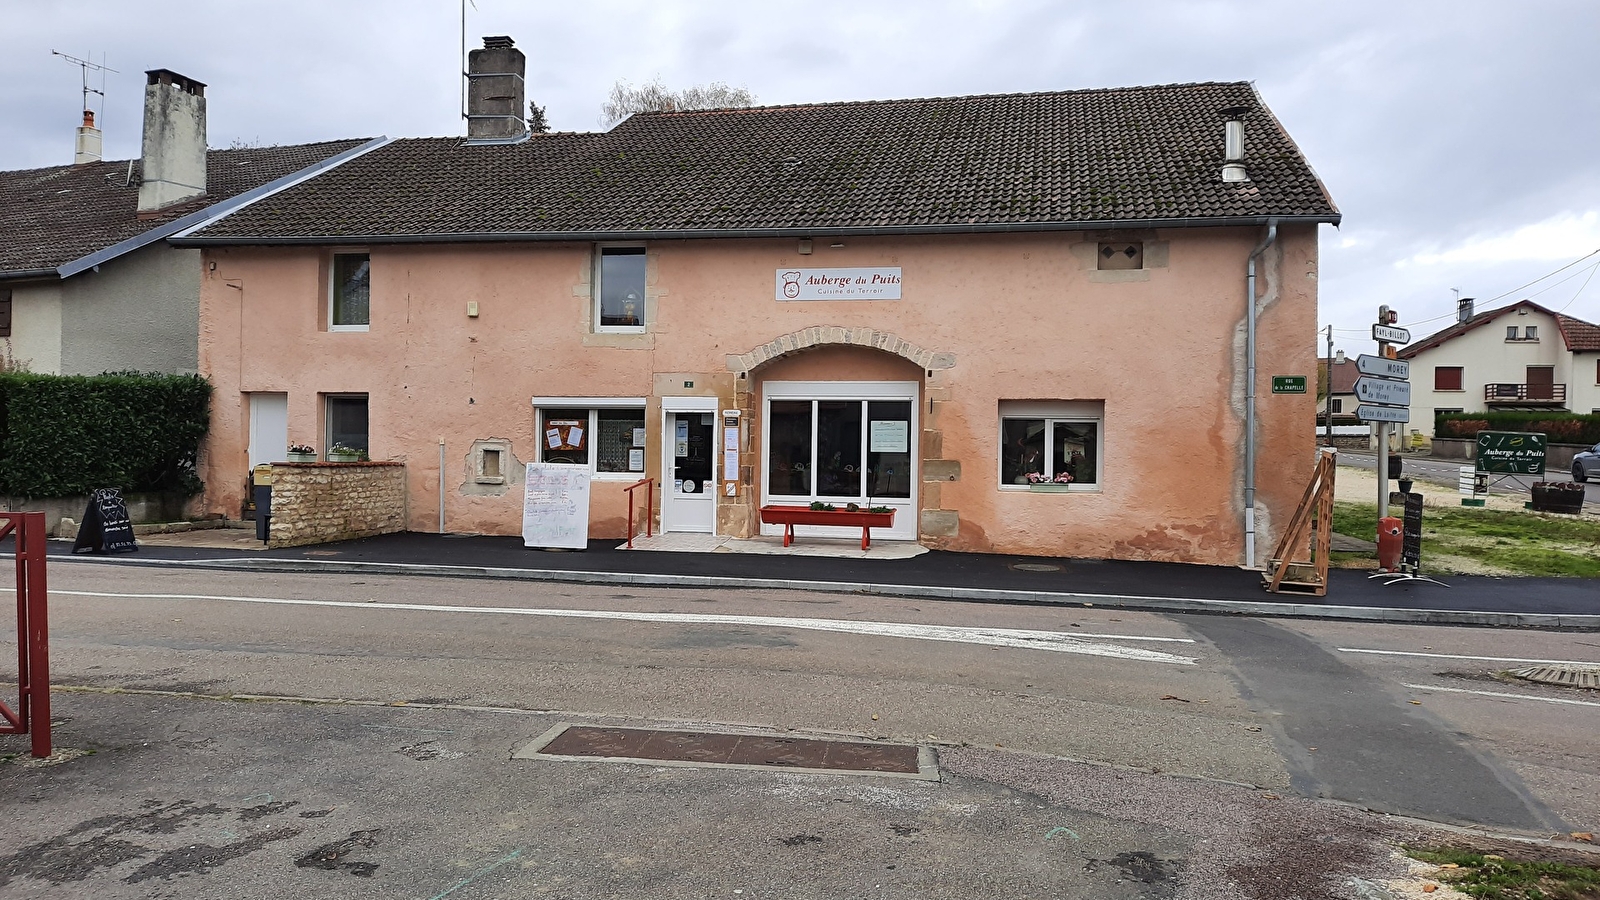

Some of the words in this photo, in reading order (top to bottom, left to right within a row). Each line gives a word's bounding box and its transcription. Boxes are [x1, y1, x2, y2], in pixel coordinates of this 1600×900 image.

[805, 275, 852, 288] Auberge
[855, 276, 867, 285] du
[871, 274, 901, 284] Puits
[1376, 327, 1405, 340] FAYL-BILLOT
[1361, 359, 1366, 369] 4
[1387, 363, 1407, 375] MOREY
[1368, 381, 1384, 391] Village
[1375, 392, 1389, 401] Morey
[1484, 448, 1514, 456] Auberge
